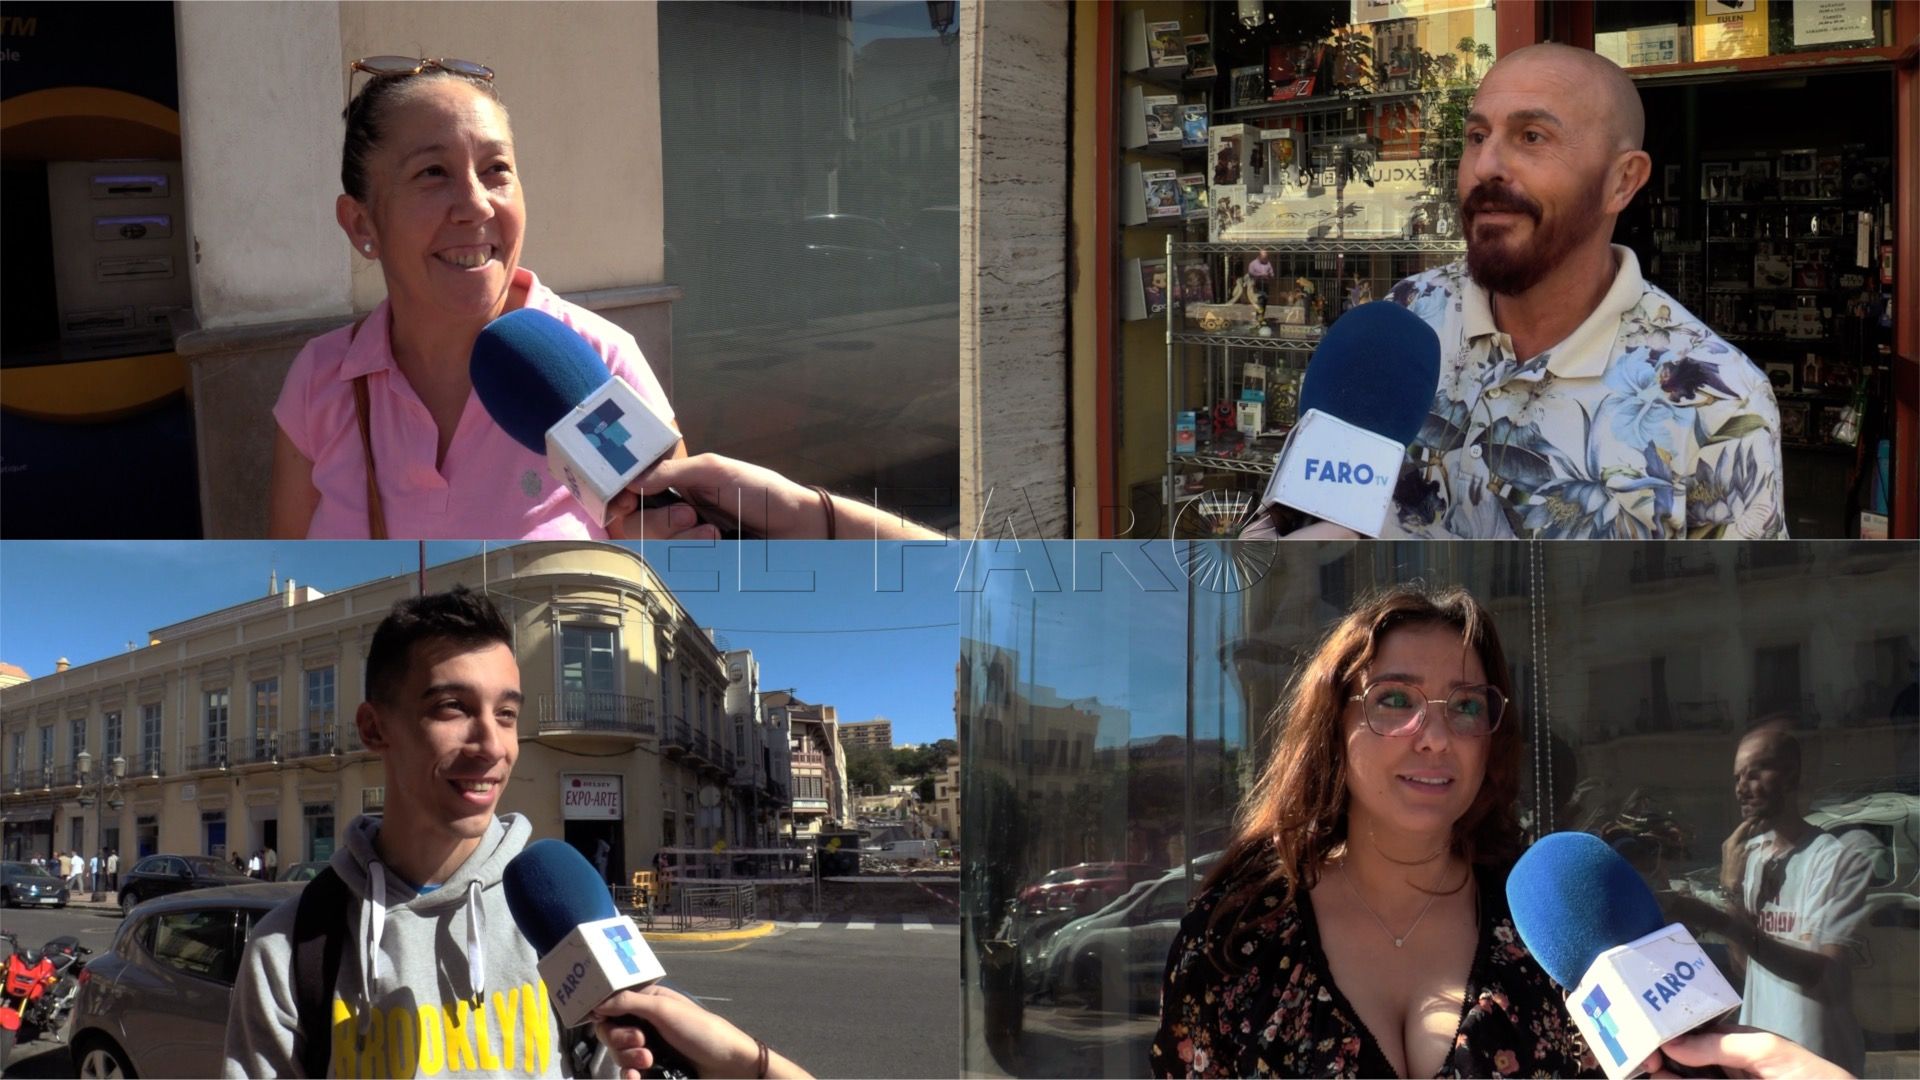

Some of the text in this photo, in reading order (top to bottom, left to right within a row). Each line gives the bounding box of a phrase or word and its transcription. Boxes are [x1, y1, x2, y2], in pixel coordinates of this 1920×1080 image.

[1717, 14, 1744, 24] EULEN
[1304, 458, 1389, 487] FARO TV
[565, 790, 618, 808] EXPO-ARTE
[556, 962, 585, 1006] FARO
[1642, 961, 1695, 1012] FARO
[335, 978, 550, 1079] BROOKLYN
